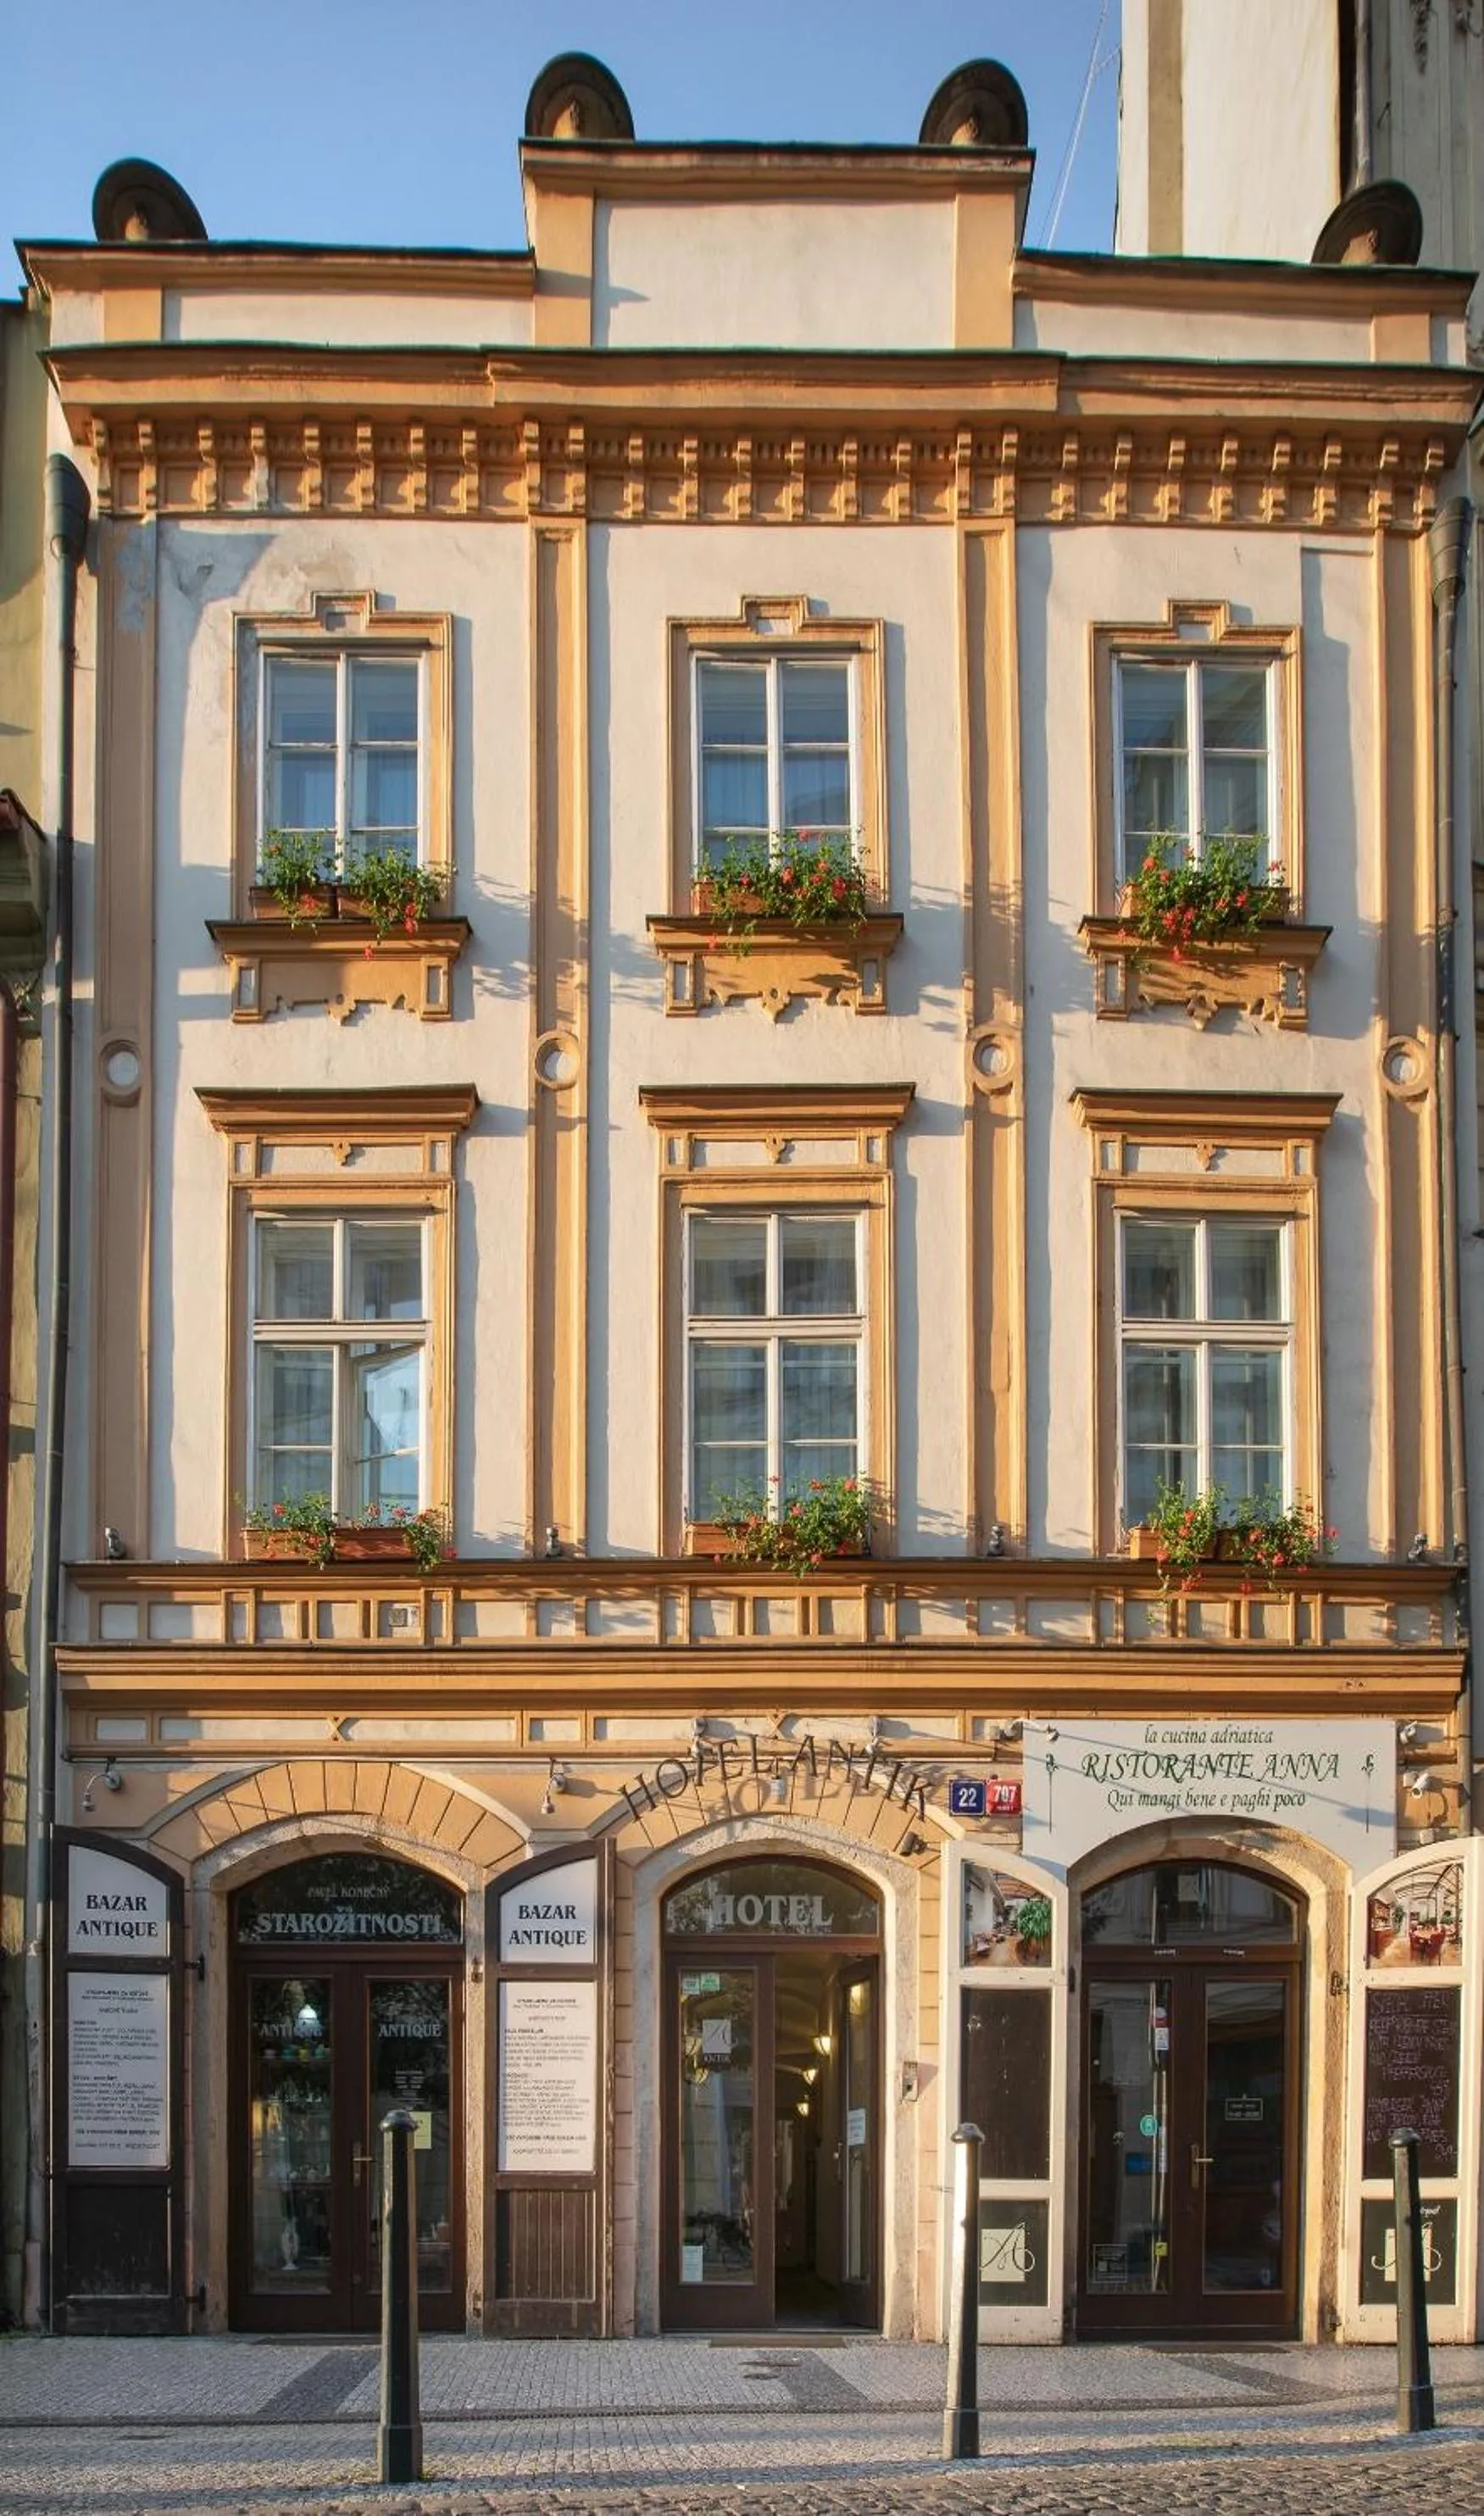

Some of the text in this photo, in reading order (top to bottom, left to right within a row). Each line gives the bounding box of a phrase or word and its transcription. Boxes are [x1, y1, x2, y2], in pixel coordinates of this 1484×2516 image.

[1144, 1724, 1274, 1744] la cucina adriatica
[1081, 1751, 1340, 1783] RISTORANTE ANNA
[619, 1734, 937, 1823] HOTEL ANTIK
[959, 1787, 977, 1807] 22
[992, 1784, 1018, 1803] 707
[1108, 1788, 1306, 1812] Qui mangi bene e paghi poco
[86, 1895, 147, 1911] BAZAR
[518, 1905, 577, 1920] BAZAR
[711, 1894, 834, 1926] HOTEL
[76, 1920, 158, 1939] ANTIQUE
[509, 1929, 587, 1948] ANTIQUE
[379, 2023, 442, 2037] ANTIQUE
